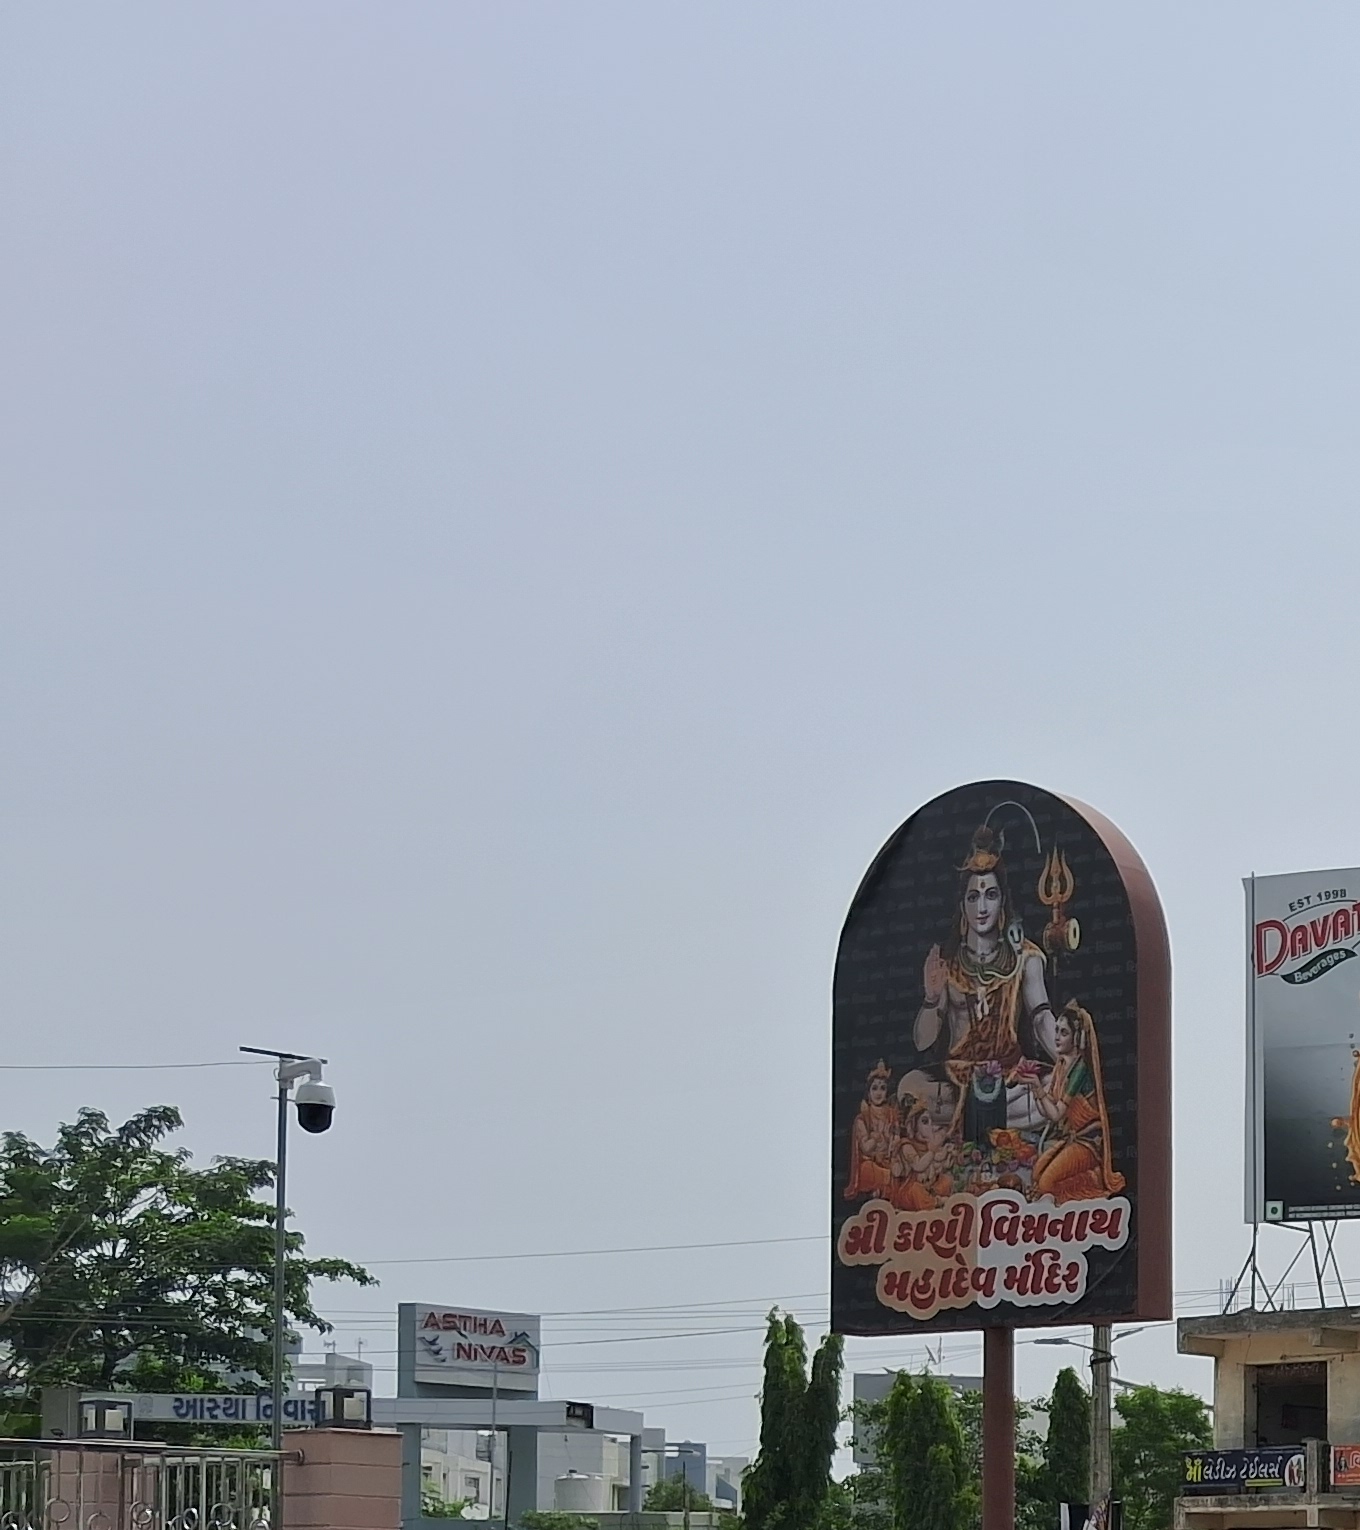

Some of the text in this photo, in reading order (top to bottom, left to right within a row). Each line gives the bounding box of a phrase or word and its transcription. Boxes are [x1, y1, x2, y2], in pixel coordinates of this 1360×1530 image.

[1288, 888, 1347, 912] EST 1998
[1294, 949, 1347, 983] Beverages
[893, 1203, 974, 1259] કાશી
[884, 1249, 1080, 1310] મહાદેવ મંદિર
[423, 1312, 505, 1336] ASTHA
[455, 1342, 527, 1365] NIVAS
